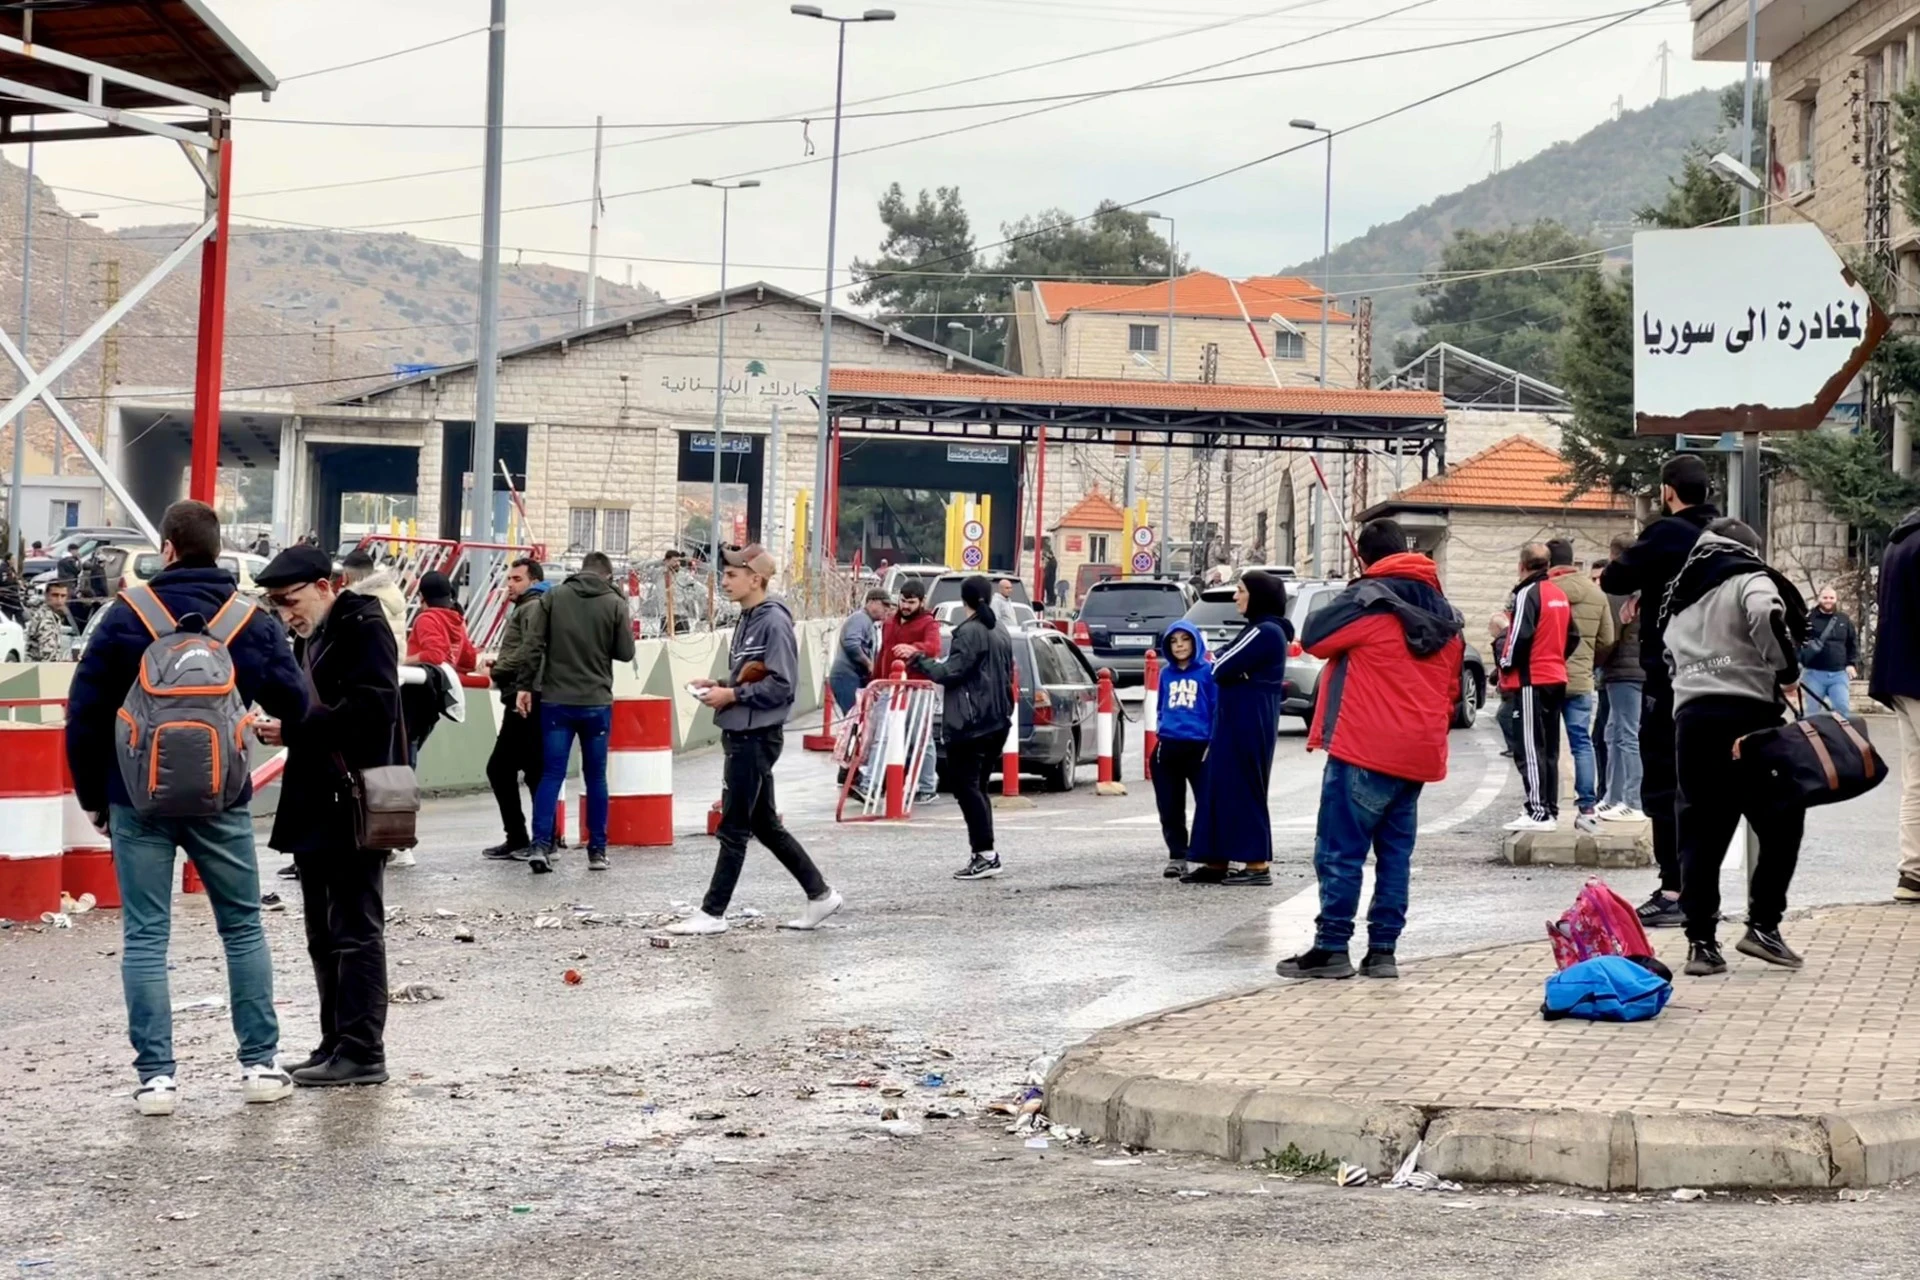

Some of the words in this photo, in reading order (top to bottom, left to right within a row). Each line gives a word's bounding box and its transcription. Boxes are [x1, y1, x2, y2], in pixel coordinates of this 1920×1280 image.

[1642, 309, 1716, 356] سوريا
[1725, 305, 1766, 354] الى
[1777, 299, 1863, 351] لمغادرة
[1168, 692, 1197, 709] CAT
[1169, 678, 1198, 695] BAD
